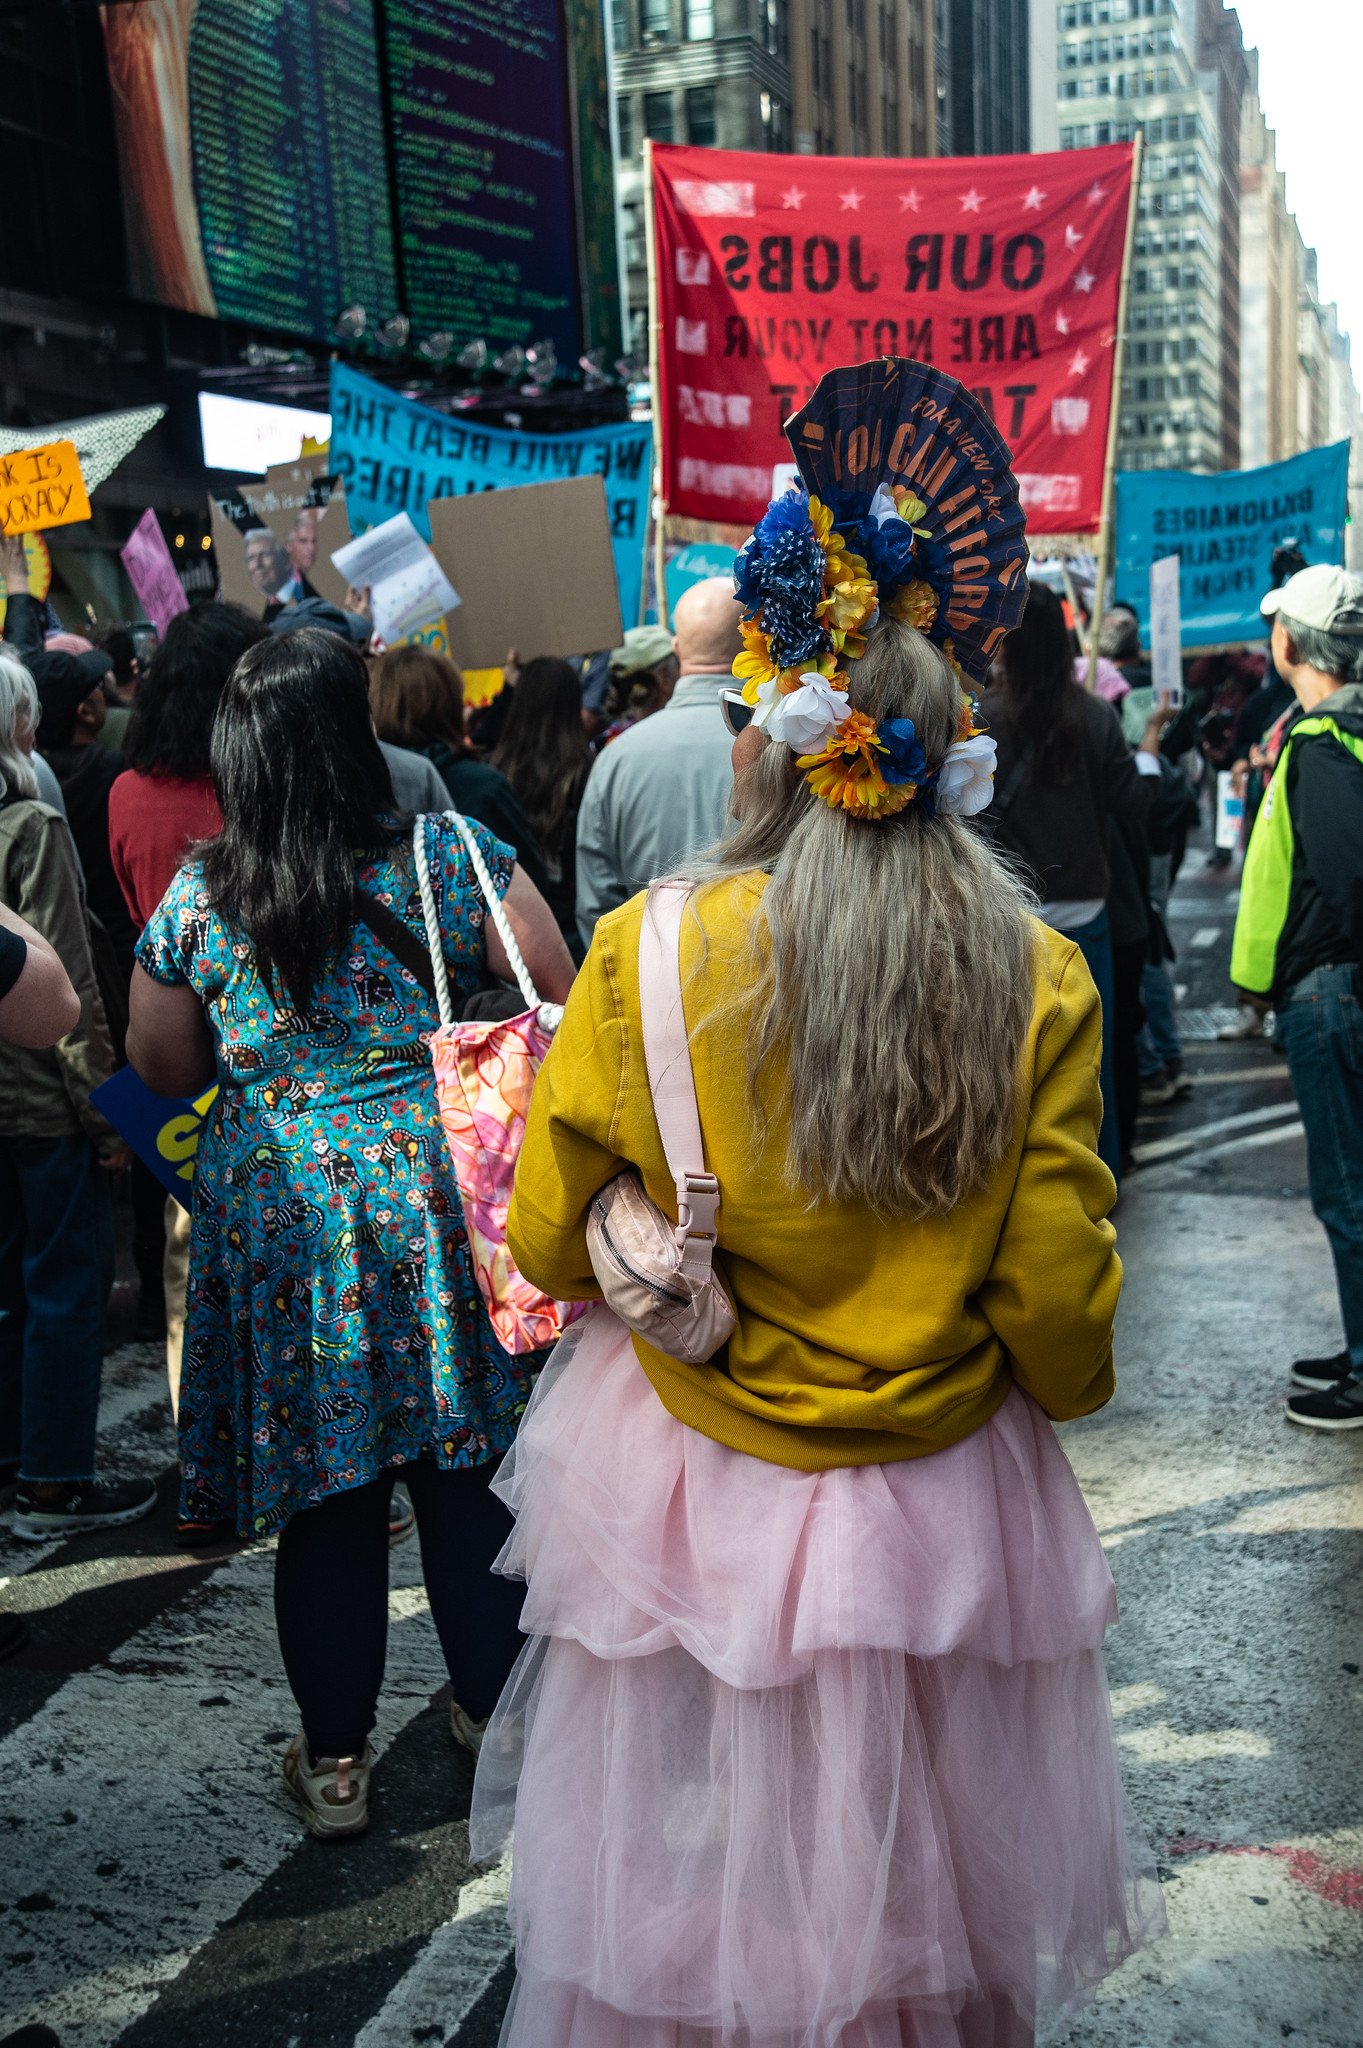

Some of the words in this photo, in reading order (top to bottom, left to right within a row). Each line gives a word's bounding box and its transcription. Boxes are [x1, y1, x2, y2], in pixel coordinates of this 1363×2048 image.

[887, 422, 957, 499] CAN
[910, 396, 950, 426] FOR
[943, 417, 961, 435] A
[957, 431, 994, 471] NEW
[980, 478, 1005, 523] ORK
